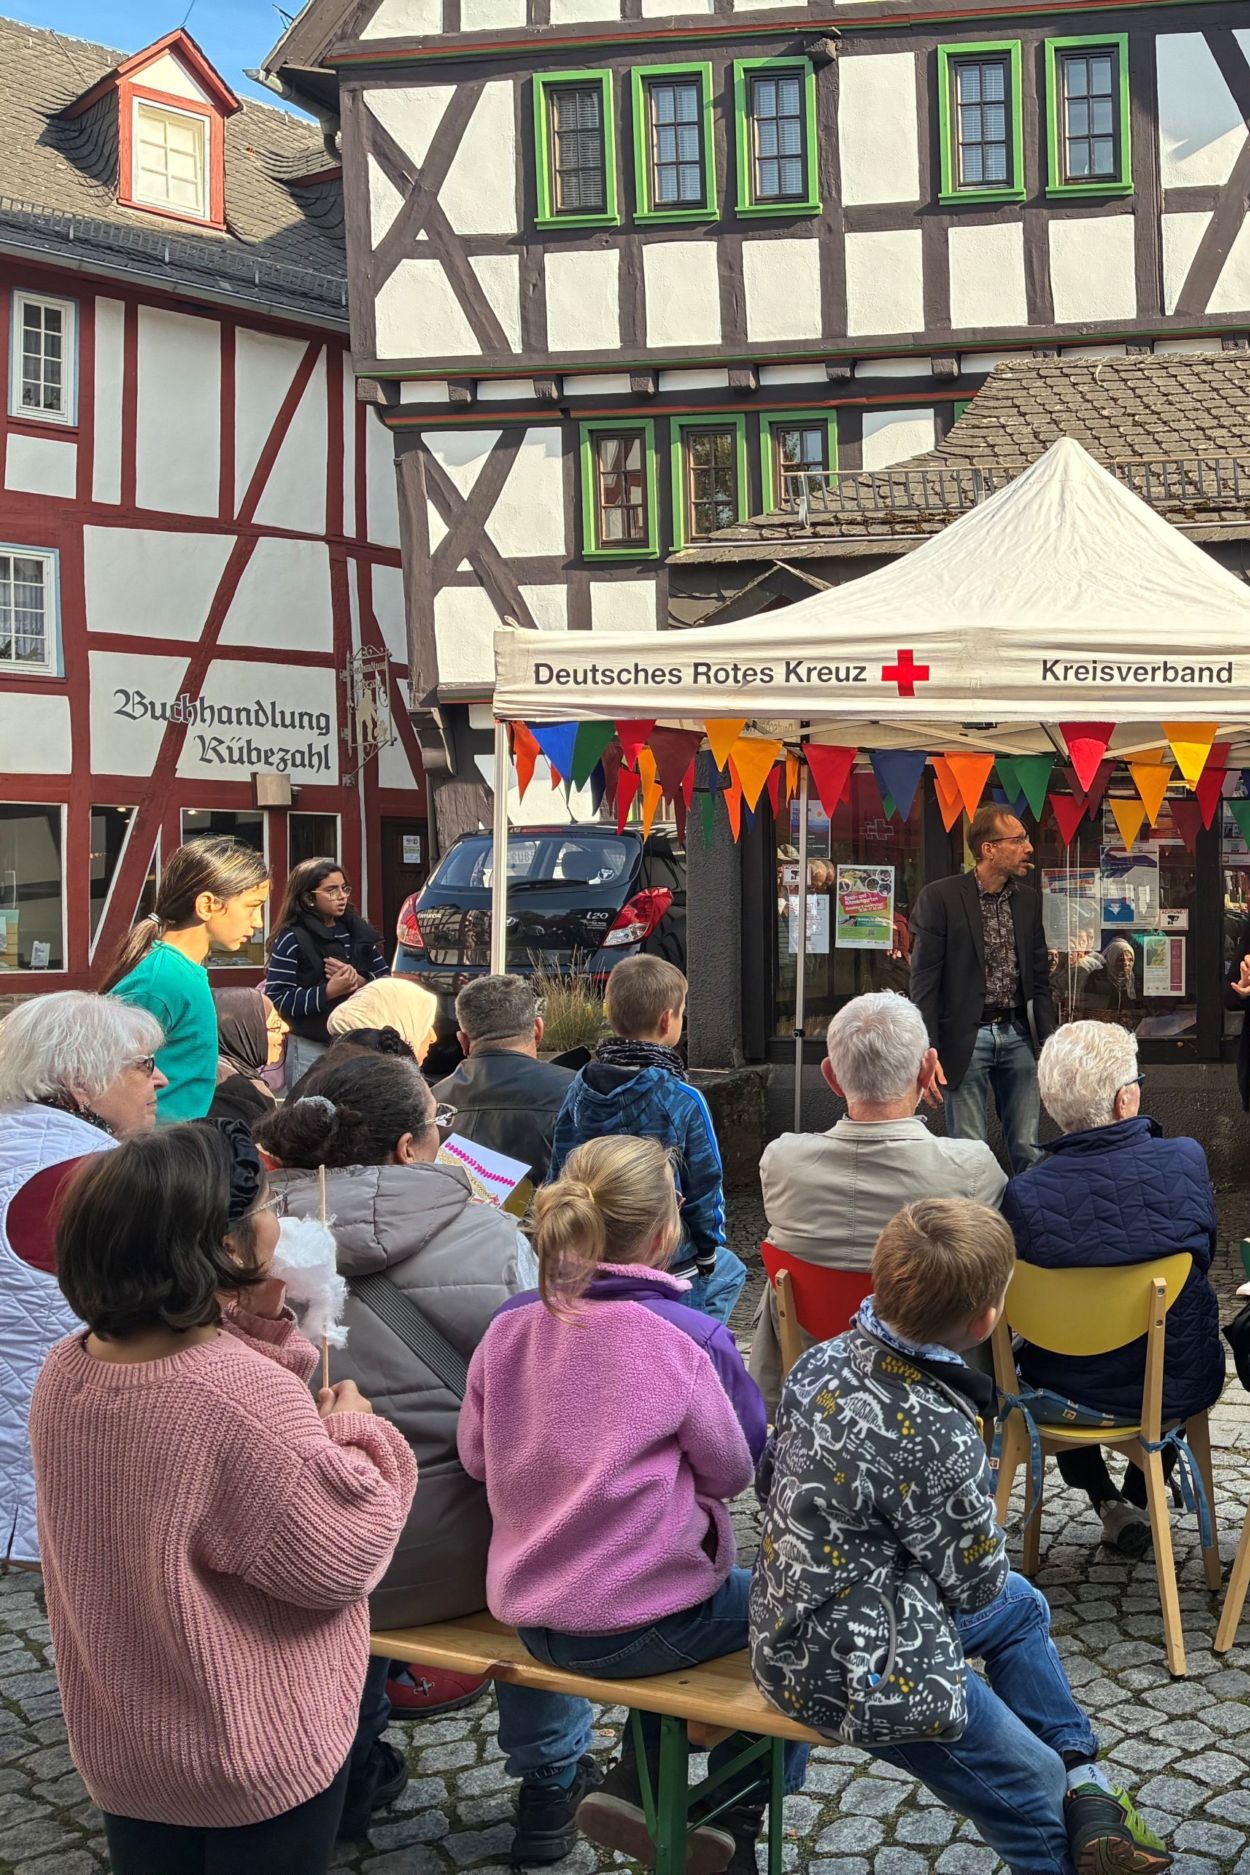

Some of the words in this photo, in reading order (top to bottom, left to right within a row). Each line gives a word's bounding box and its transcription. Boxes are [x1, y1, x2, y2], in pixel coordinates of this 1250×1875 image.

[534, 662, 682, 685] Deutsches
[693, 662, 774, 684] Rotes
[784, 660, 867, 683] Kreuz
[1041, 659, 1233, 684] Kreisverband
[113, 688, 330, 737] Buchhandlung
[193, 733, 331, 774] Rübezahl
